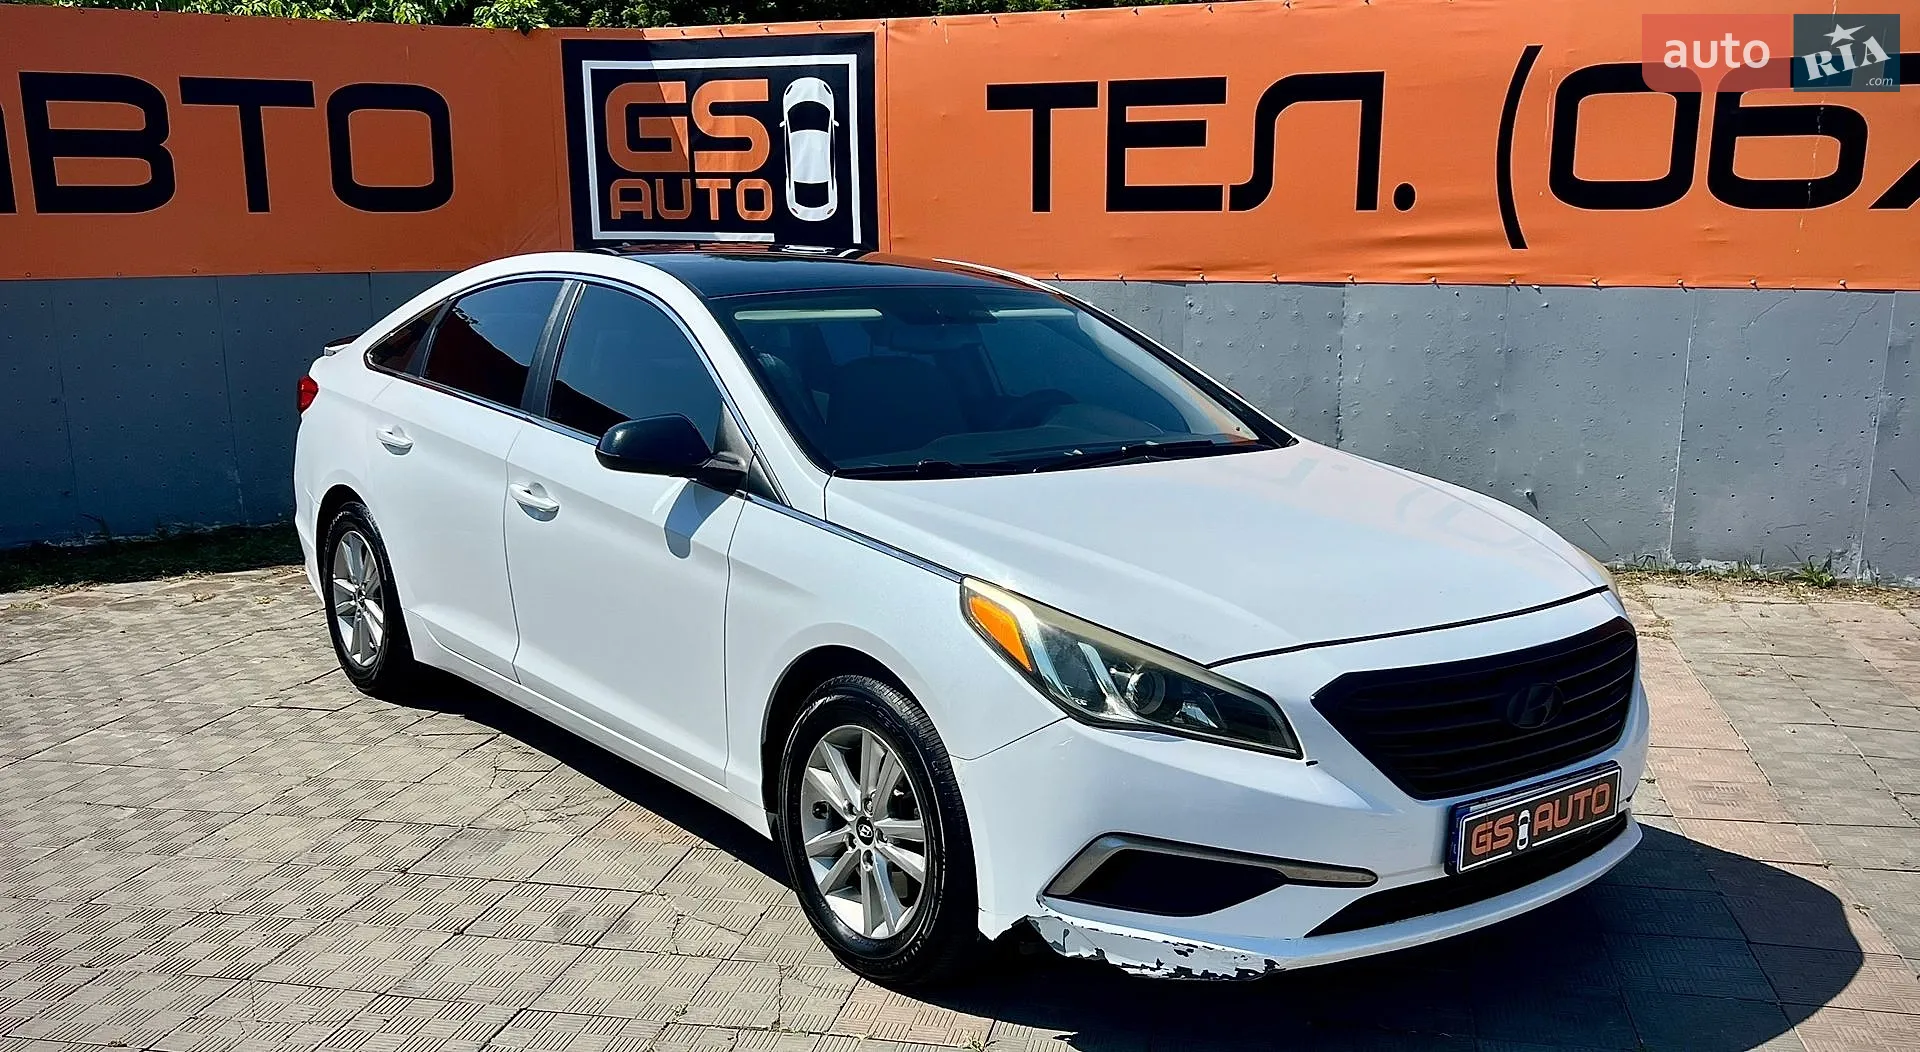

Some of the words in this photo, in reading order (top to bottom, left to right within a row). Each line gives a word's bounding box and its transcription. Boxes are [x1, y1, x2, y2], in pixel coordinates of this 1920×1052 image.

[0, 70, 456, 215] ВТО
[605, 78, 770, 174] GS
[986, 70, 1417, 214] ТЕЛ.
[610, 178, 773, 221] AUTO
[1471, 813, 1515, 856] GS
[1532, 782, 1612, 837] AUTO
